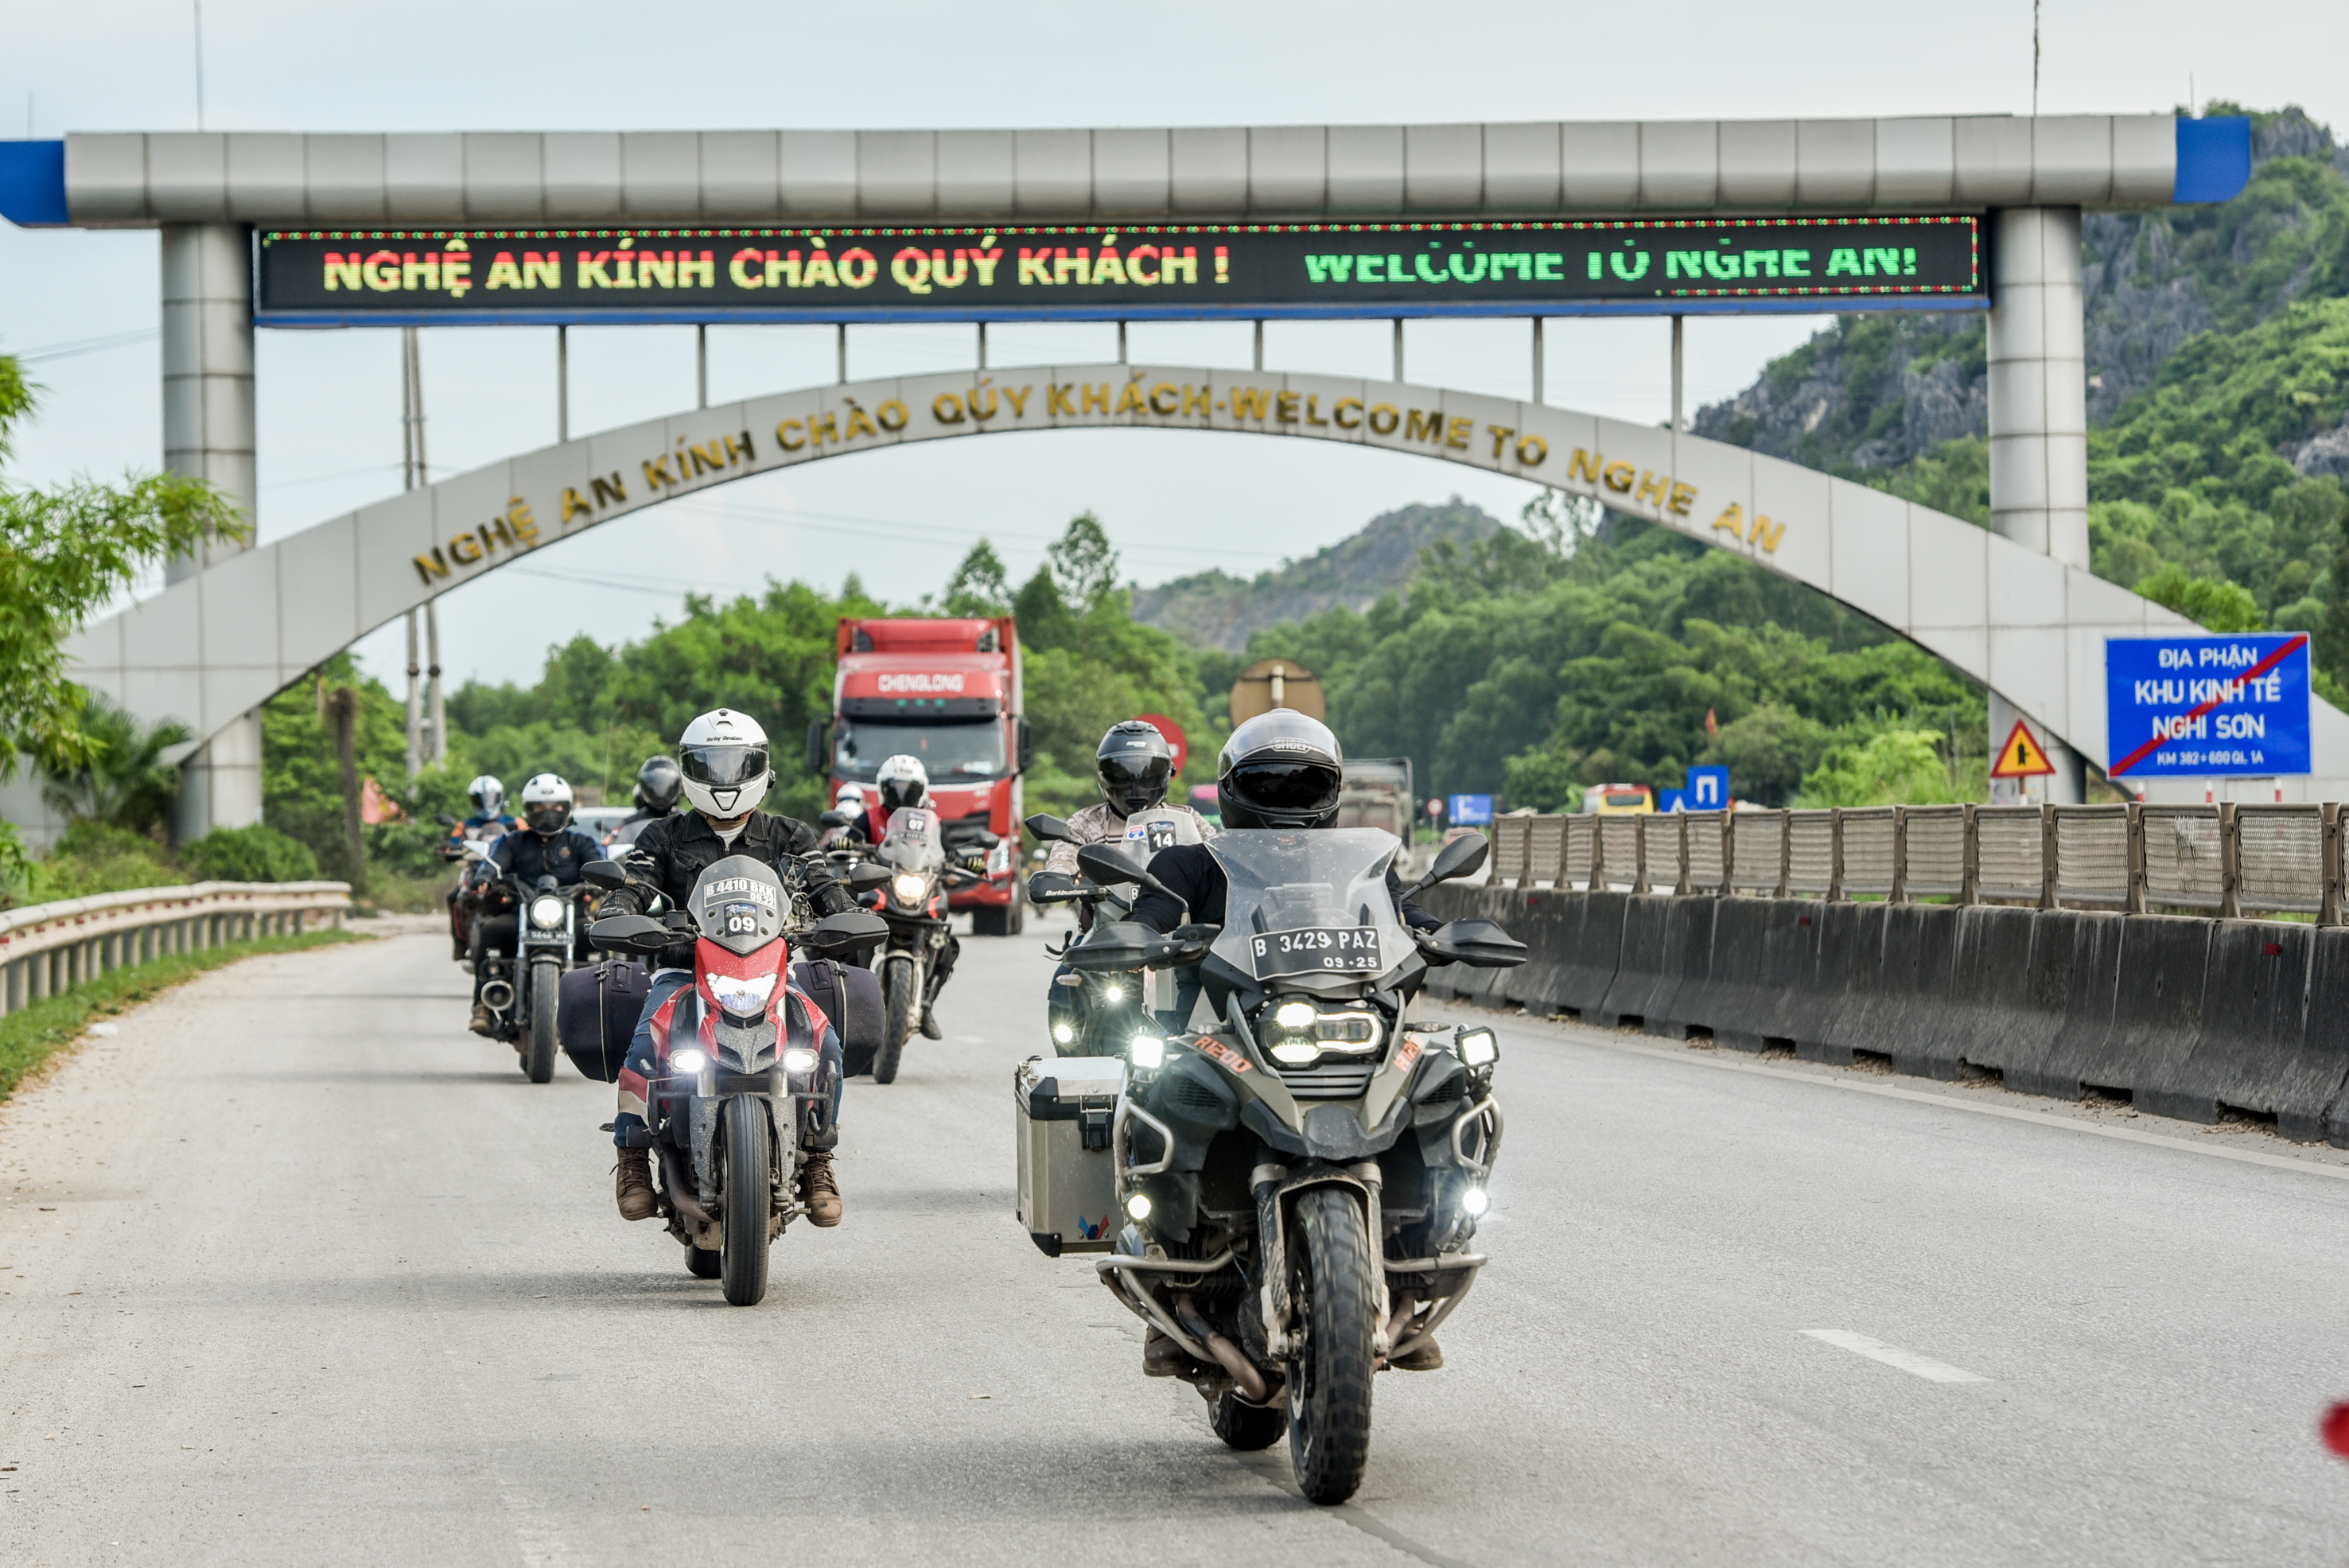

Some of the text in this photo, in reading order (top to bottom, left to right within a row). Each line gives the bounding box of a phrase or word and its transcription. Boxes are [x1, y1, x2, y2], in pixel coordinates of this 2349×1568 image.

[324, 239, 473, 298] NGHỆ
[485, 251, 562, 290] AN
[577, 237, 714, 289] KÍNH
[729, 236, 877, 289] CHÀO
[890, 235, 1003, 294] QUÝ
[1017, 234, 1197, 286] KHÁCH
[1305, 243, 1565, 283] WELCOME
[413, 496, 541, 586] NGHỆ
[561, 472, 627, 523] AN
[641, 435, 756, 491] KÍNH
[775, 397, 909, 452] CHÀO
[1488, 424, 1548, 467] TO
[1568, 447, 1698, 516] NGHE
[1712, 502, 1787, 554] AN
[2158, 644, 2258, 671] ĐỊA PHẬN
[878, 674, 964, 692] CHENGLONG
[2134, 667, 2281, 705] KHU KINH TẾ
[2152, 712, 2265, 740] NGHI SƠN
[2156, 751, 2177, 765] KM
[2232, 749, 2248, 765] QL
[2250, 749, 2265, 765] 1A
[908, 819, 924, 831] 07
[1153, 832, 1173, 847] 14
[706, 880, 774, 897] B 4410 BXK
[1131, 888, 1139, 900] B
[749, 893, 775, 907] 09.22
[729, 916, 755, 932] 09
[1254, 931, 1378, 957] B 3429 PAZ
[1193, 1035, 1253, 1073] R1200
